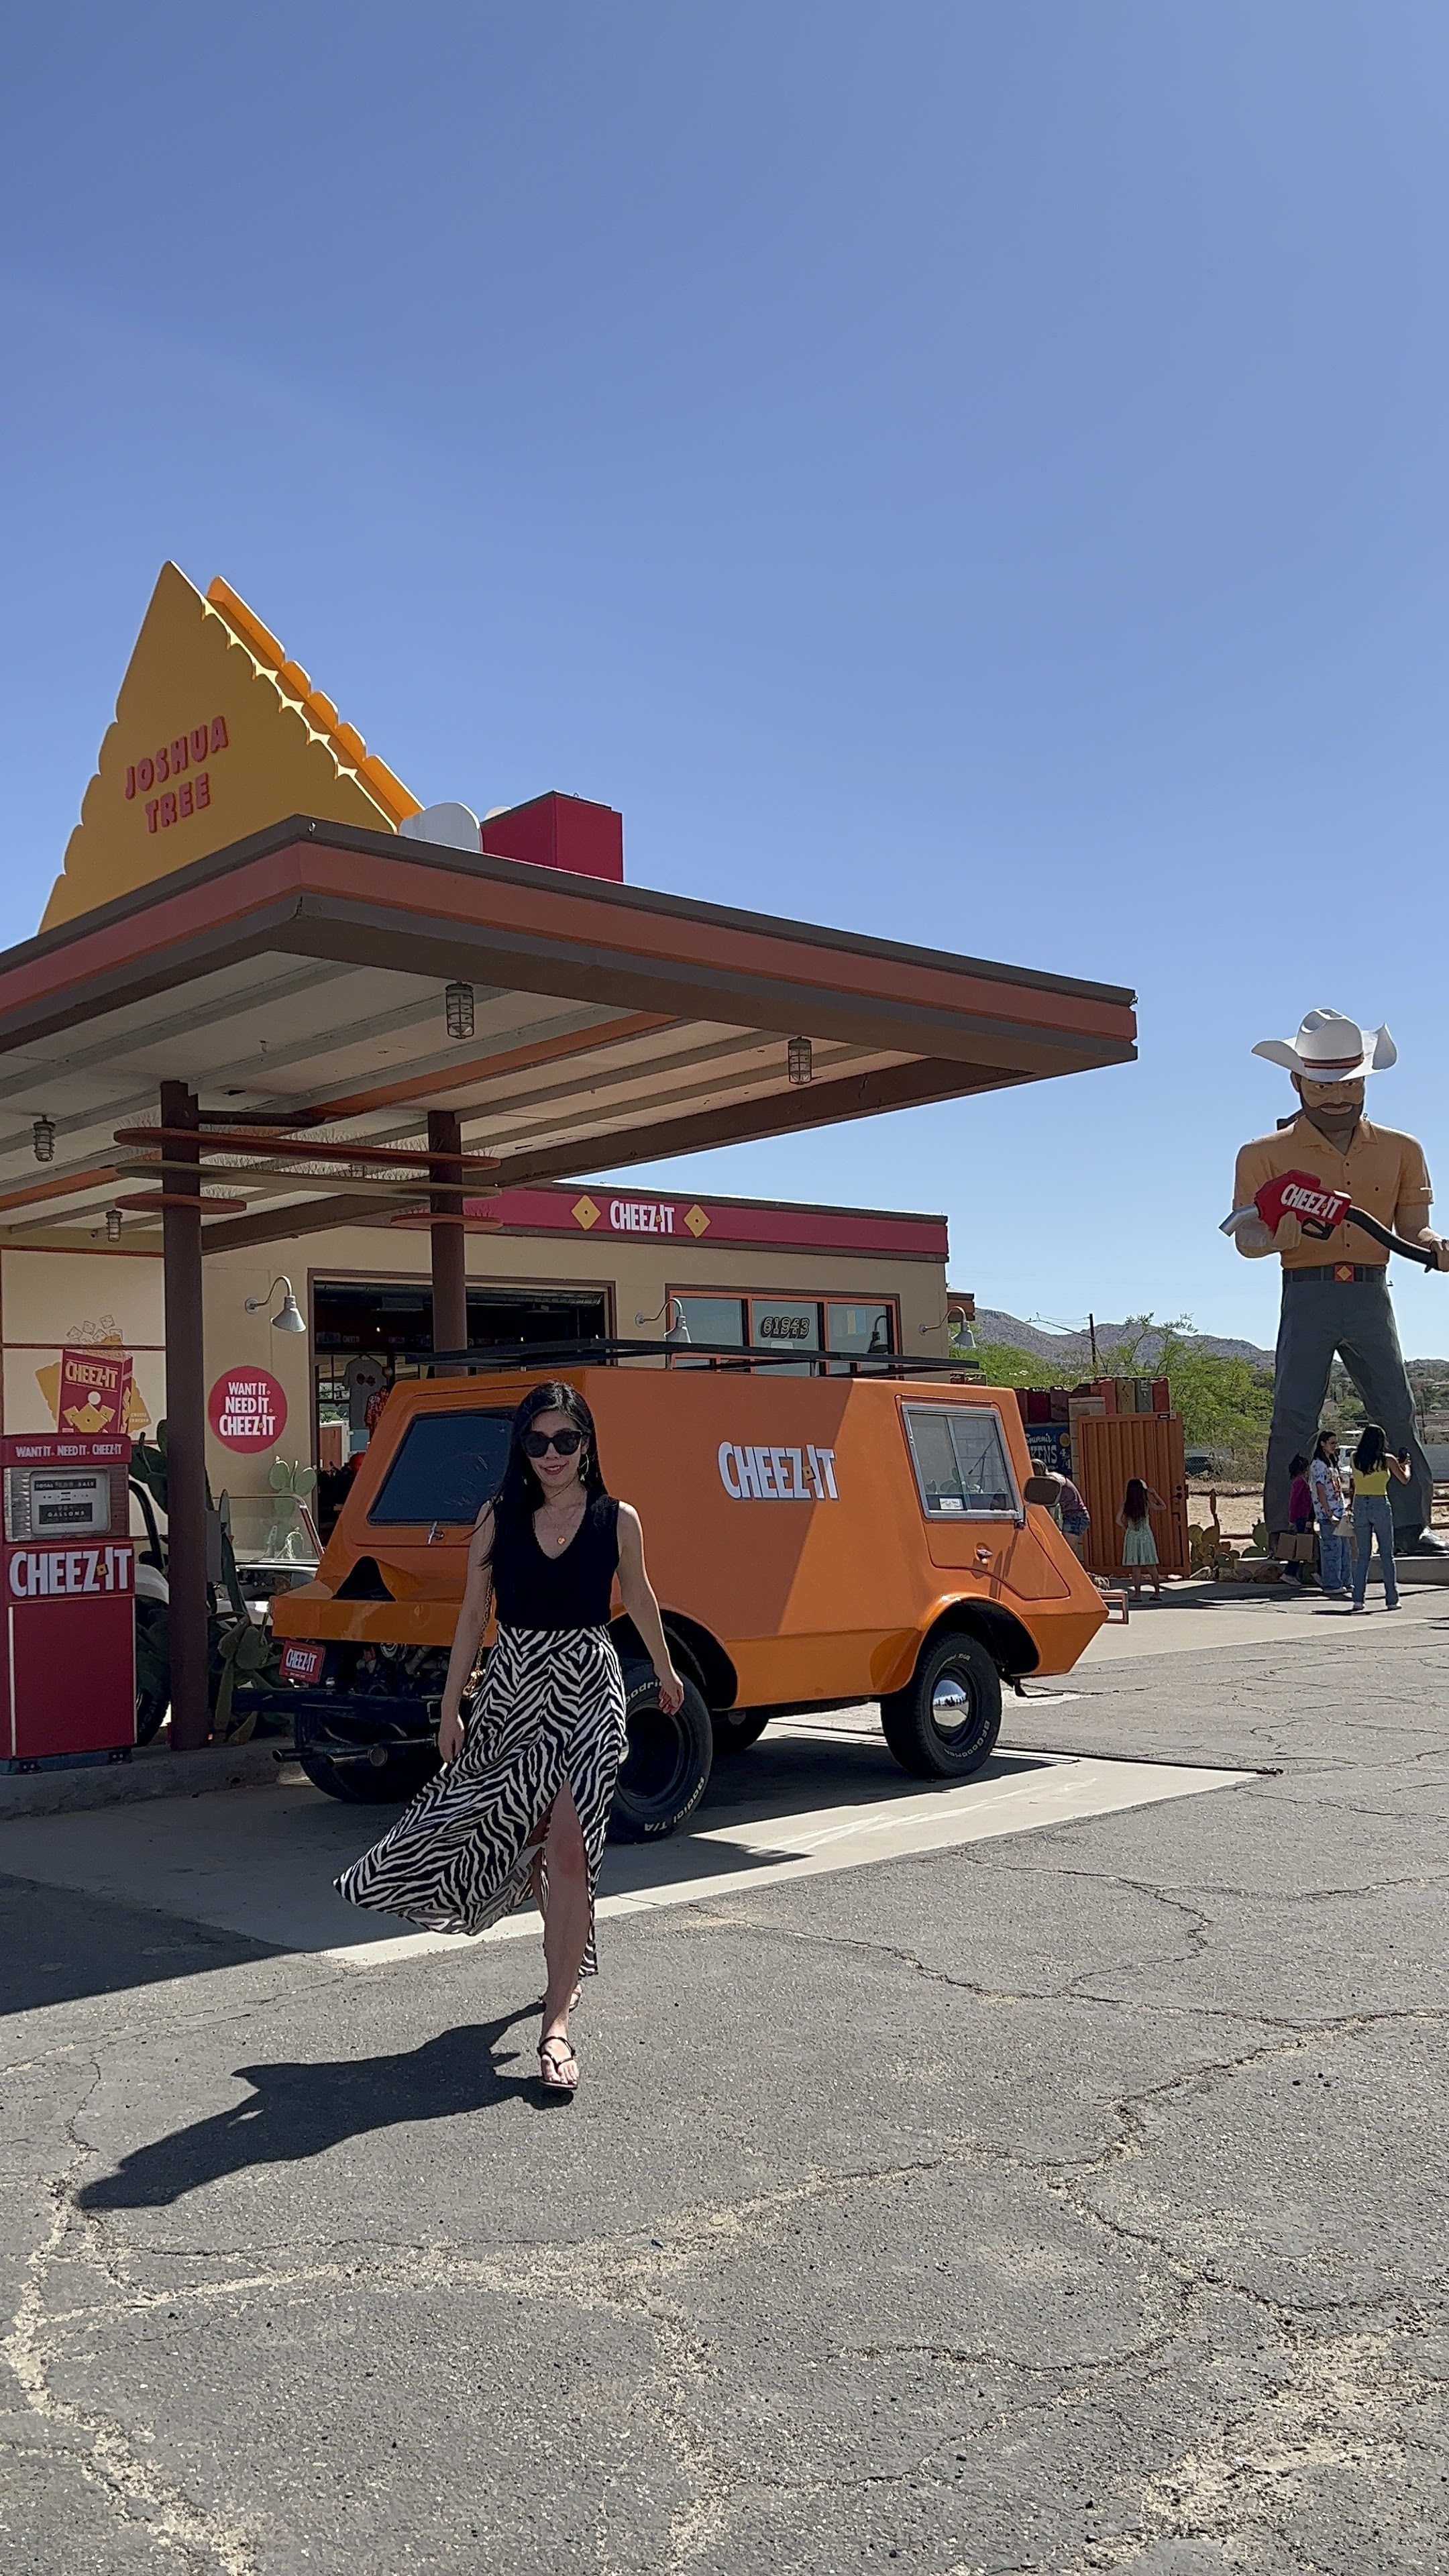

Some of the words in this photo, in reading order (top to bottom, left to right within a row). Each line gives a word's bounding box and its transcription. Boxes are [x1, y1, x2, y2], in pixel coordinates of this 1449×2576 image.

[125, 715, 229, 800] JOSHUA
[145, 772, 210, 833] TREE
[761, 1316, 810, 1339] 61943
[228, 1382, 257, 1395] WANT
[225, 1396, 257, 1413] NEED
[15, 1446, 43, 1457] WANT
[57, 1444, 78, 1456] NEED
[644, 1821, 667, 1831] T/A
